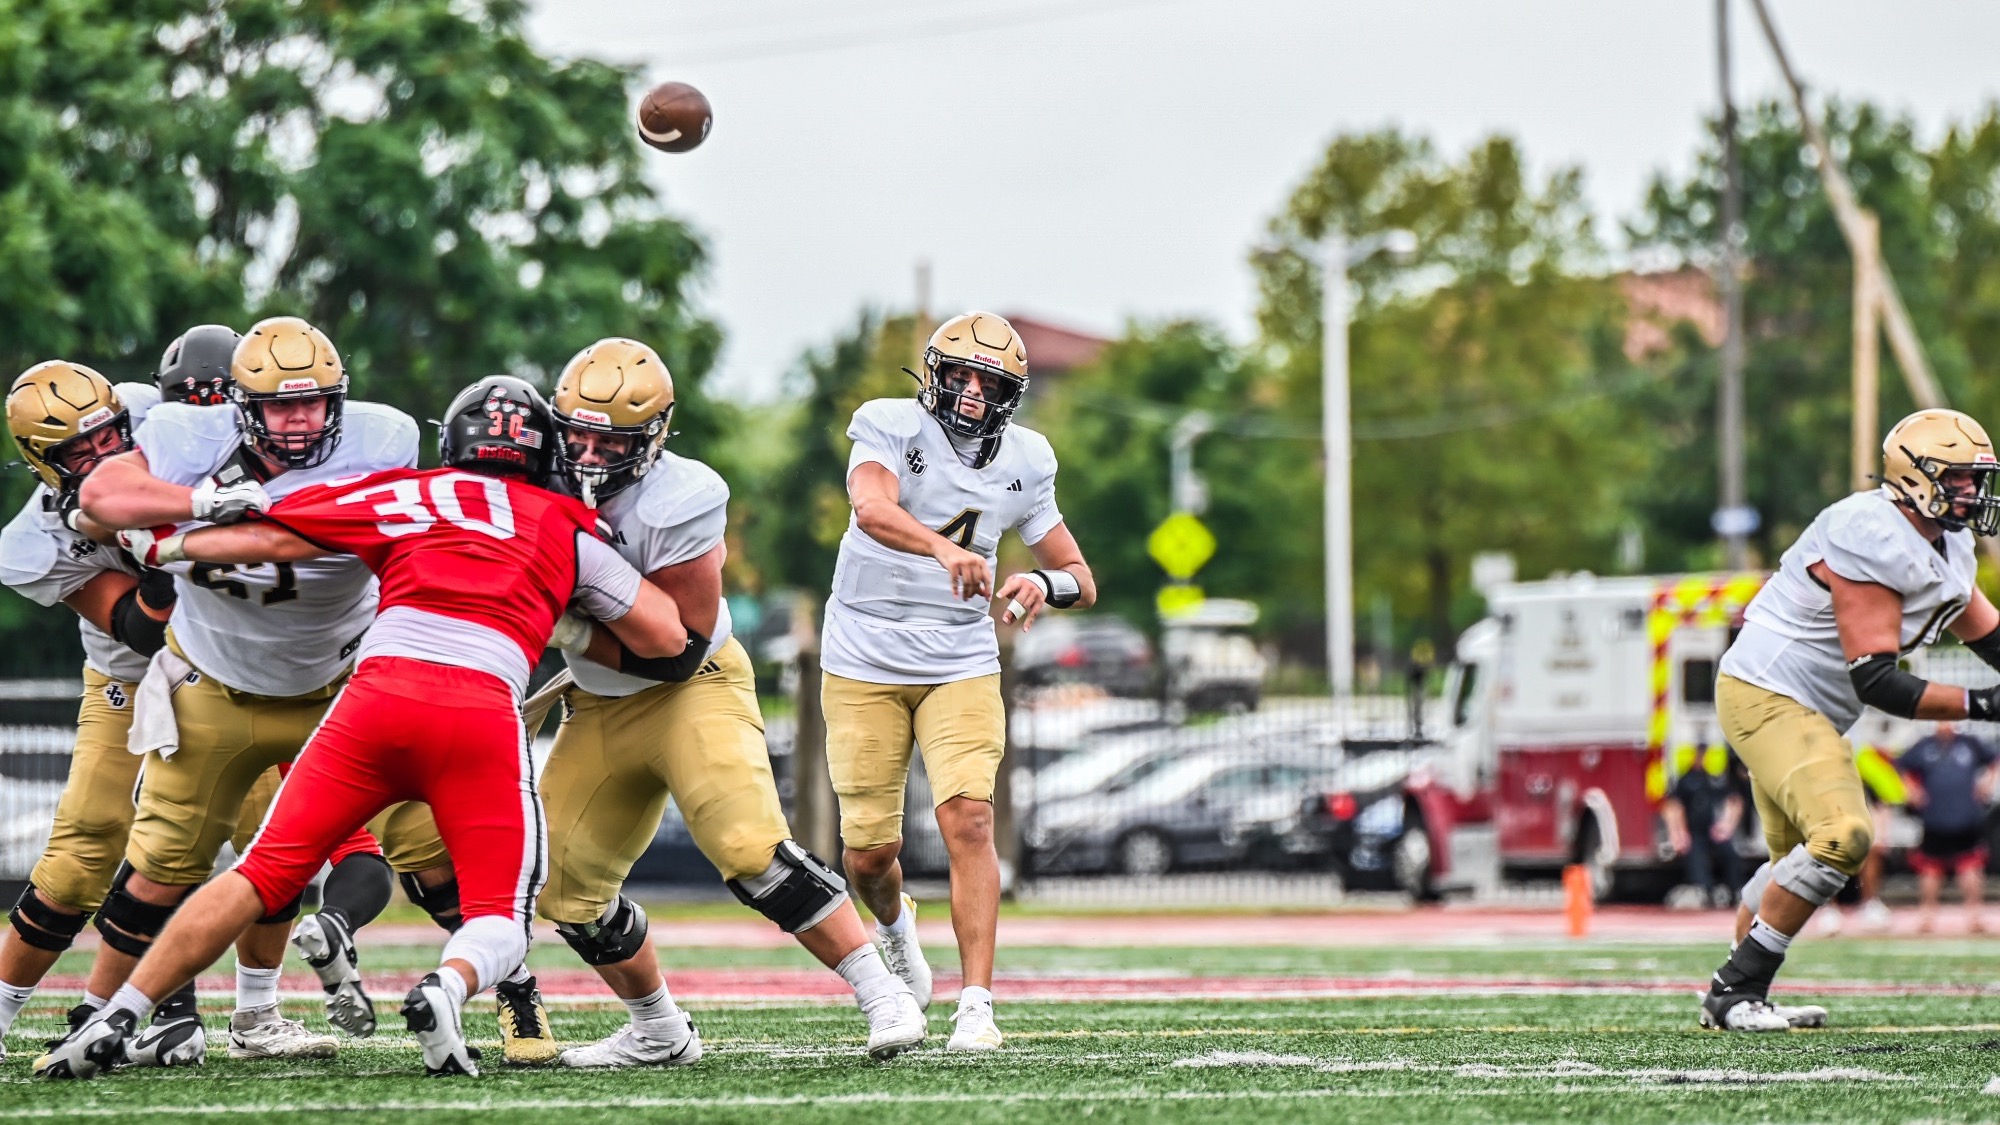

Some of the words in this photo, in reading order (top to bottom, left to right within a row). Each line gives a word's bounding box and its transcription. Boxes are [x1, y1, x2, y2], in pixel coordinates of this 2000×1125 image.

[488, 411, 524, 439] 30
[336, 472, 516, 540] 30
[936, 507, 983, 551] 4
